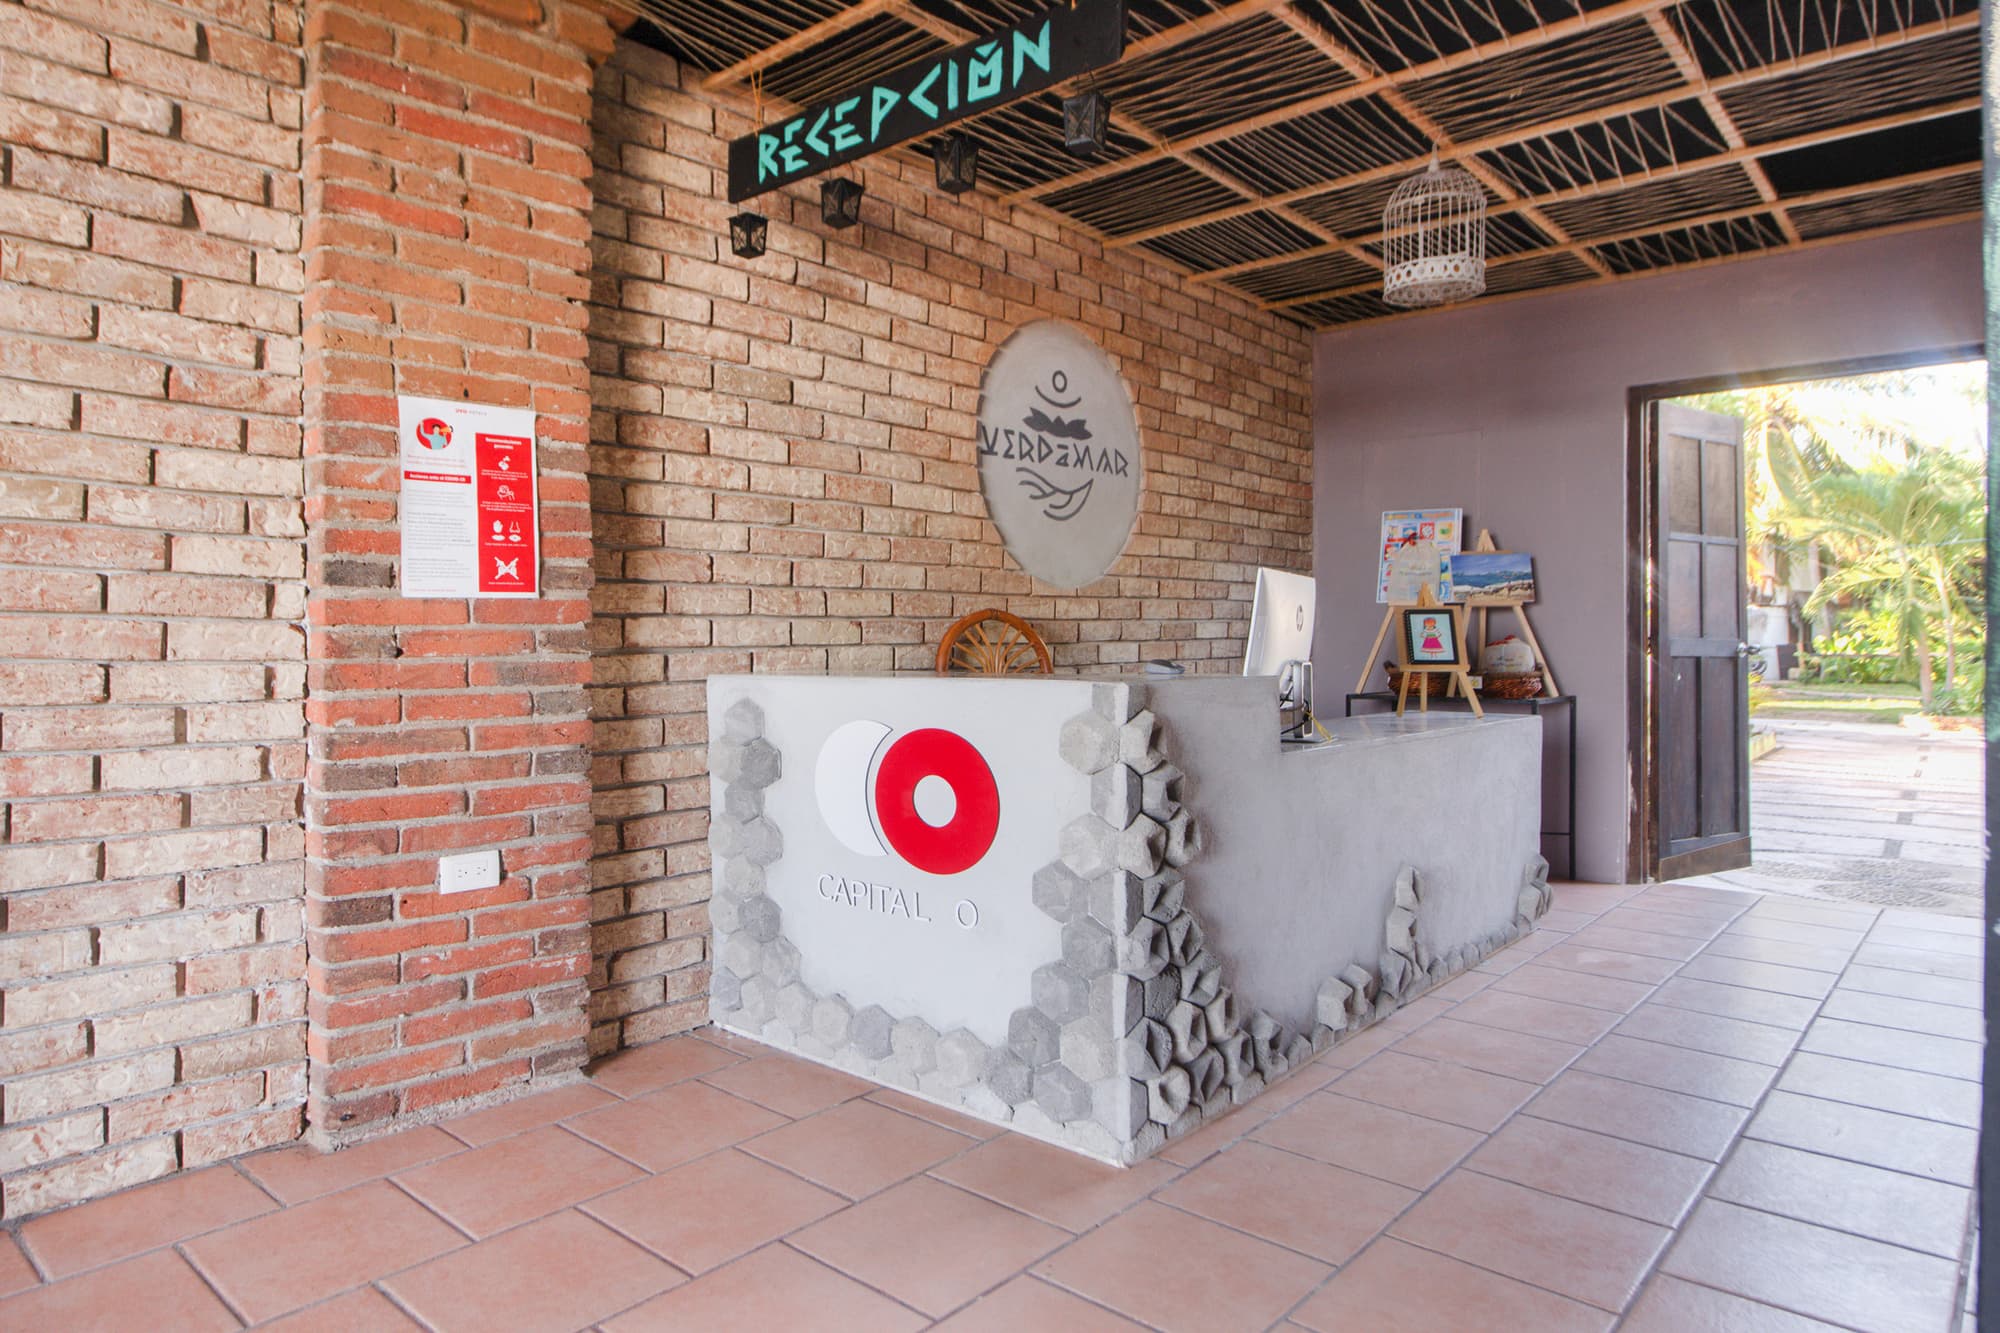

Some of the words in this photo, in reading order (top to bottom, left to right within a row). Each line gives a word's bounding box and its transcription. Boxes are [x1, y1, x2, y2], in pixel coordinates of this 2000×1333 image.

[758, 19, 1050, 184] RECEPCIÓN
[979, 425, 1130, 478] VERDEMAR
[817, 873, 932, 923] CAPITAL
[956, 899, 979, 929] O
